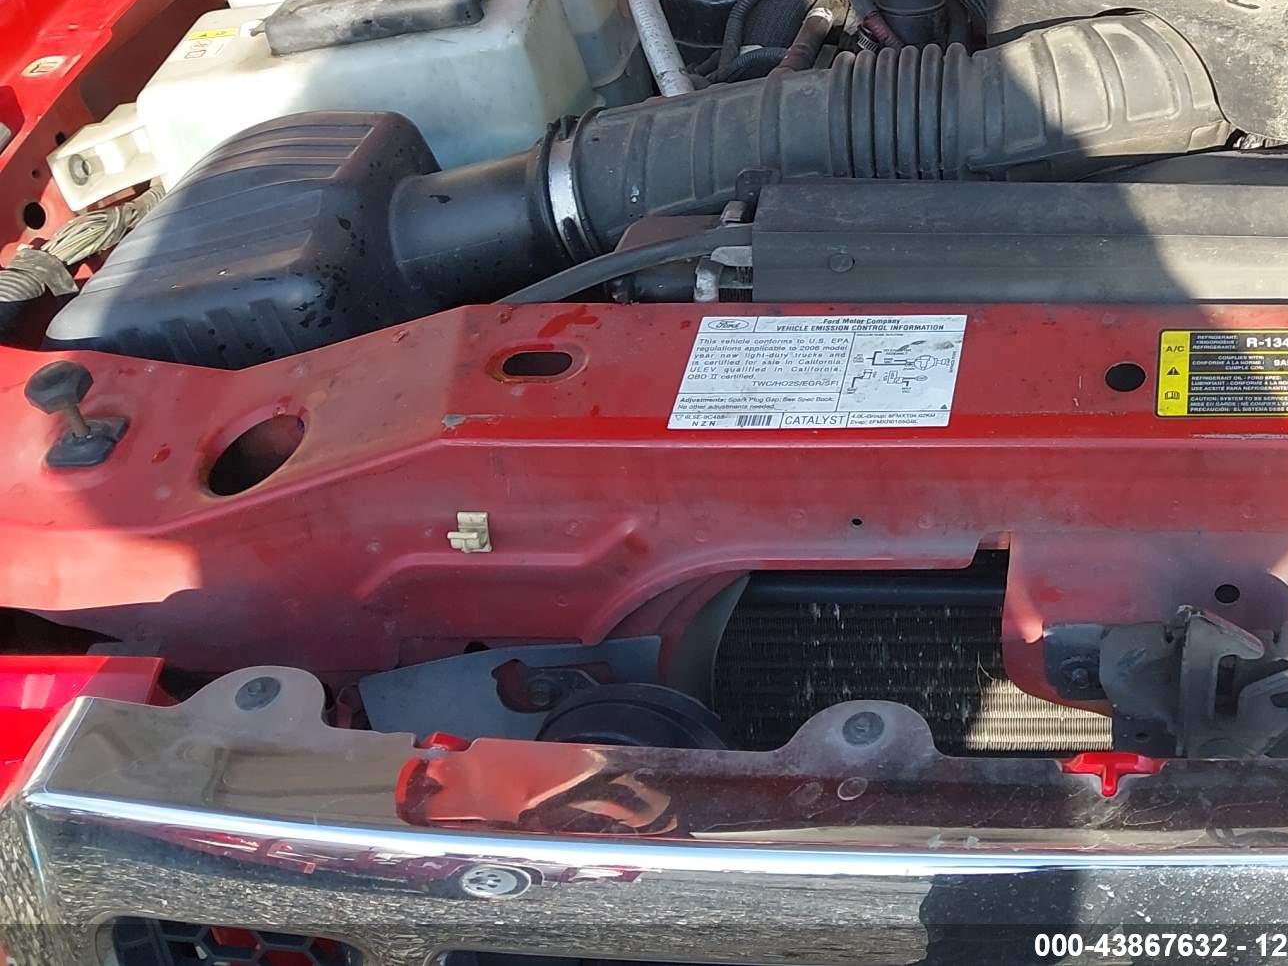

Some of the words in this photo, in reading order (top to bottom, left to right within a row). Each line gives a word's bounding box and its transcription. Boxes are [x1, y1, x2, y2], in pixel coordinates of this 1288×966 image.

[715, 320, 741, 329] Ford
[866, 318, 902, 326] Company
[1165, 345, 1185, 353] A/C
[689, 366, 717, 374] ULEV
[723, 366, 767, 374] qualified
[784, 415, 845, 426] CATALYST
